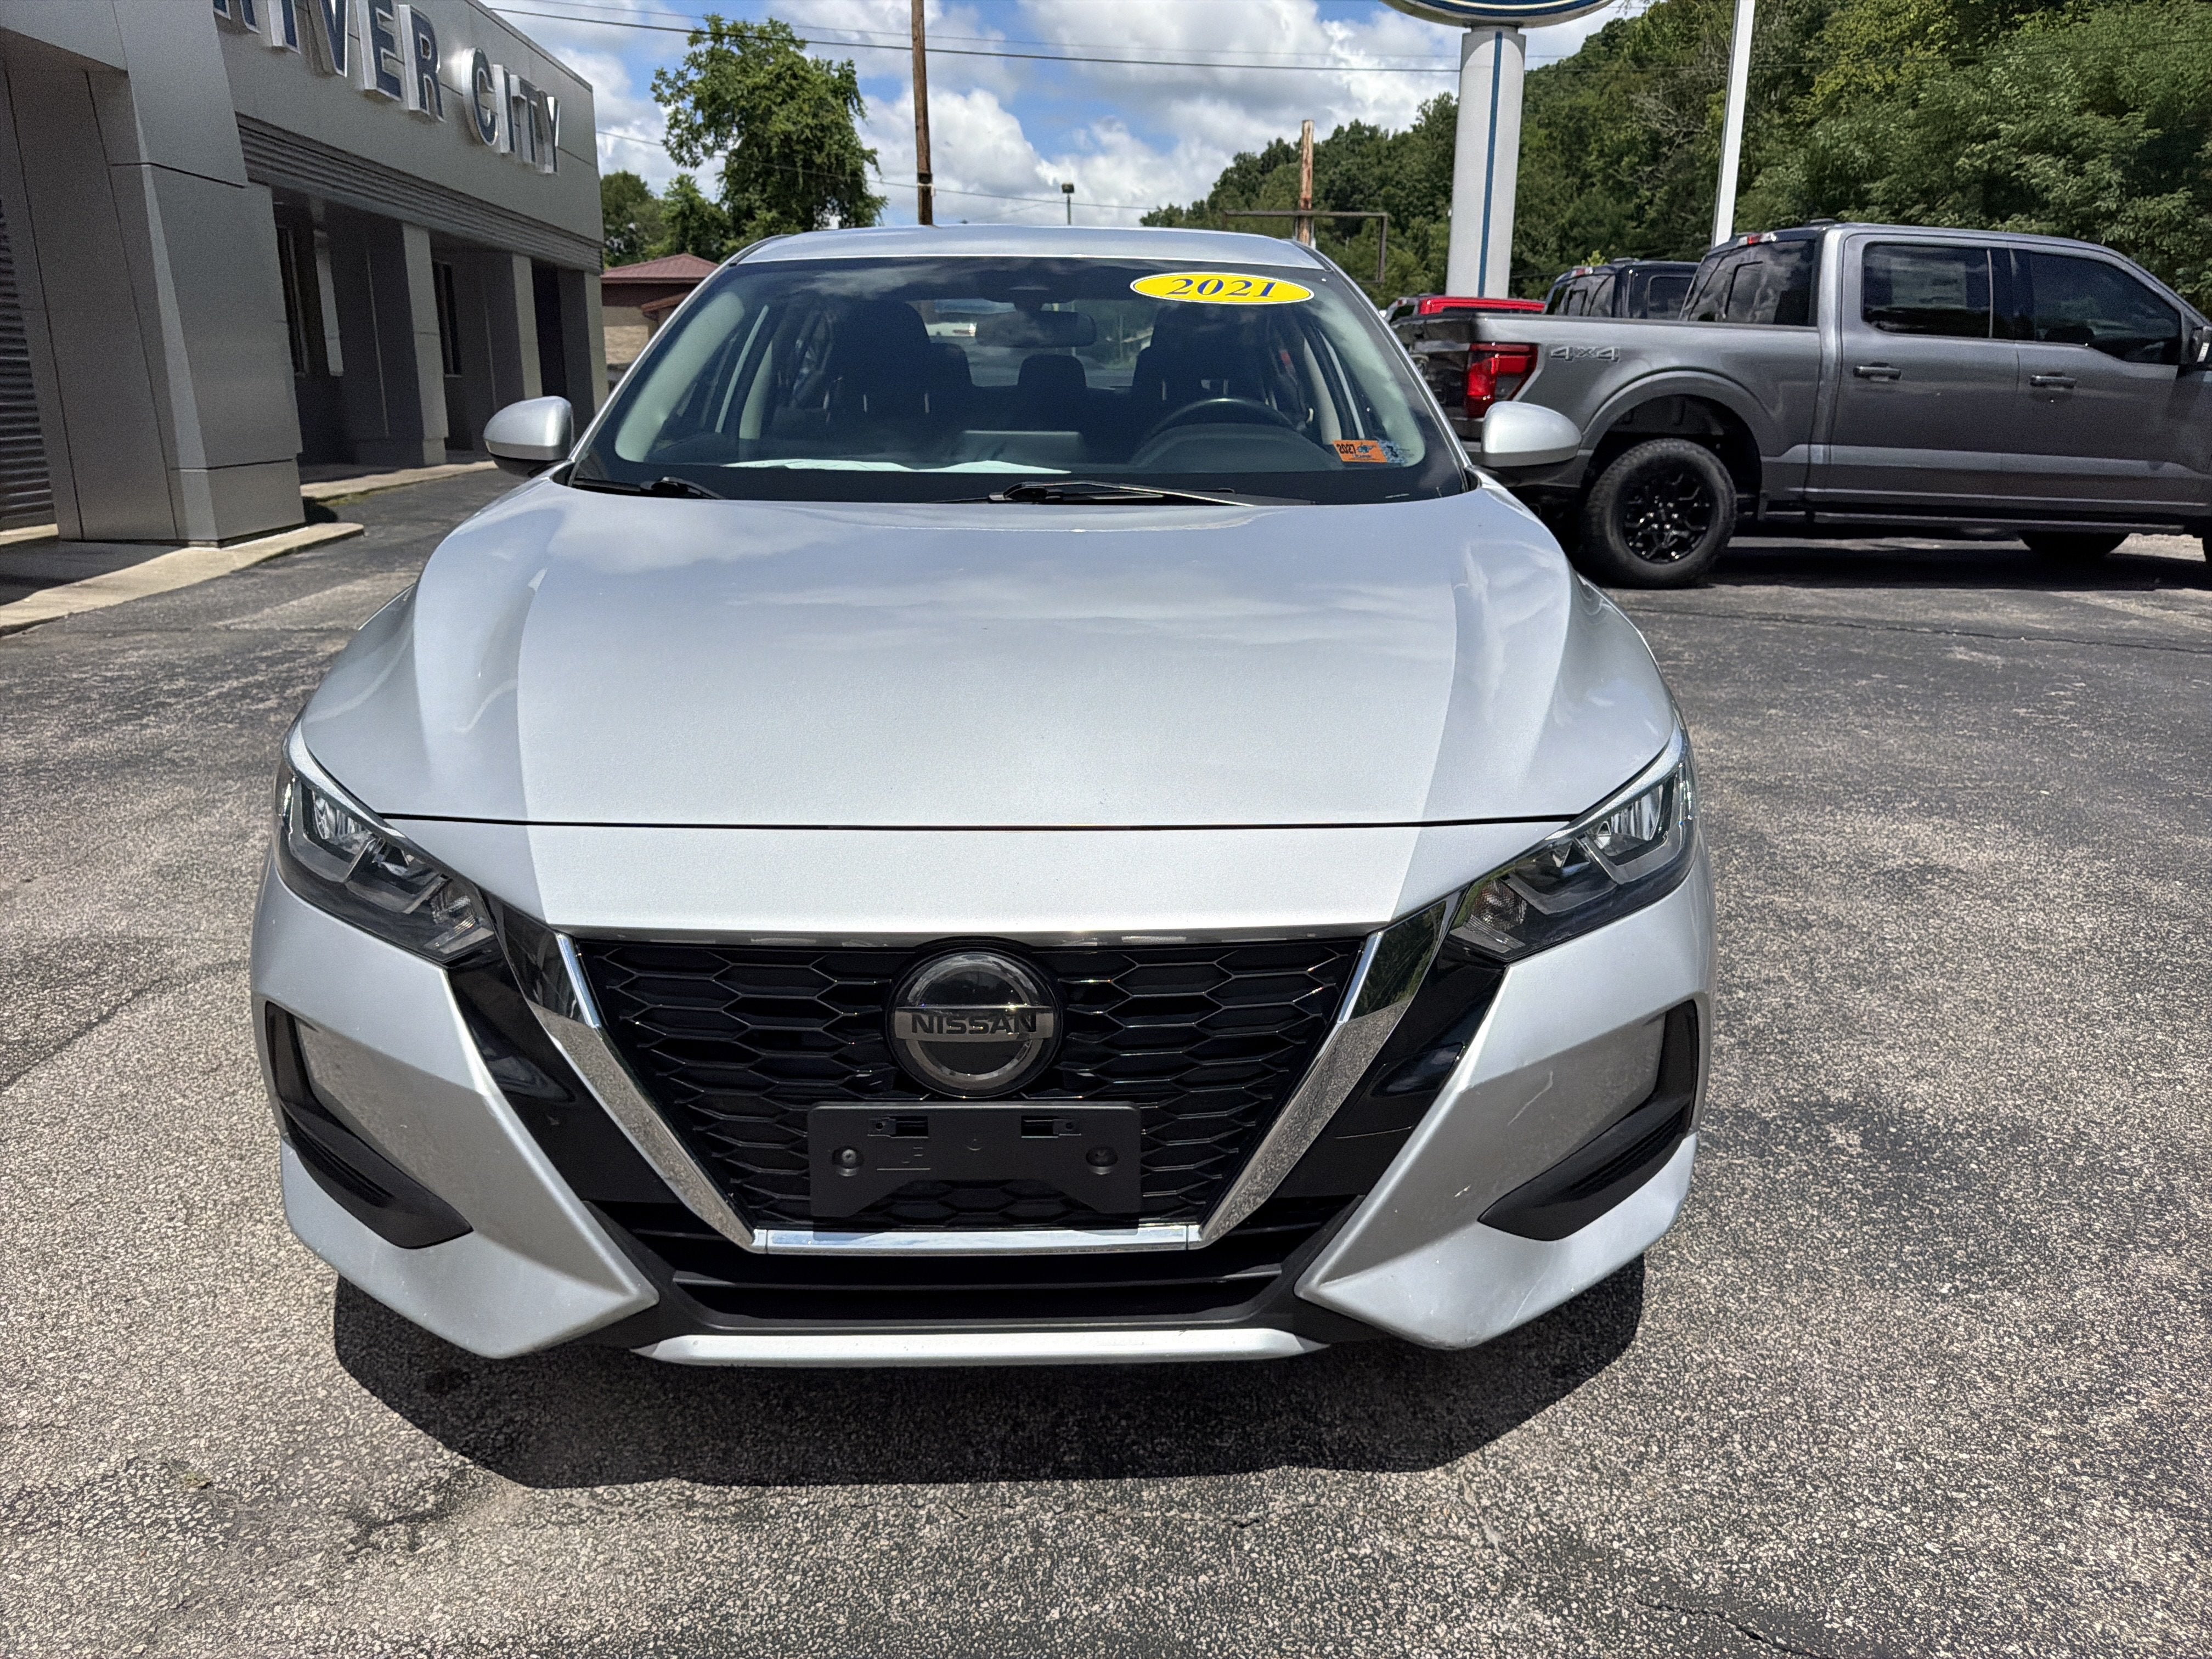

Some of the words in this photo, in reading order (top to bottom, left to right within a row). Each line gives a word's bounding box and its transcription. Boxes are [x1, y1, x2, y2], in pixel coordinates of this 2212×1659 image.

[213, 0, 445, 122] VER
[461, 47, 561, 174] CITY
[1166, 278, 1277, 298] 2021
[1336, 443, 1357, 454] 2027
[911, 1013, 1036, 1035] NISSAN
